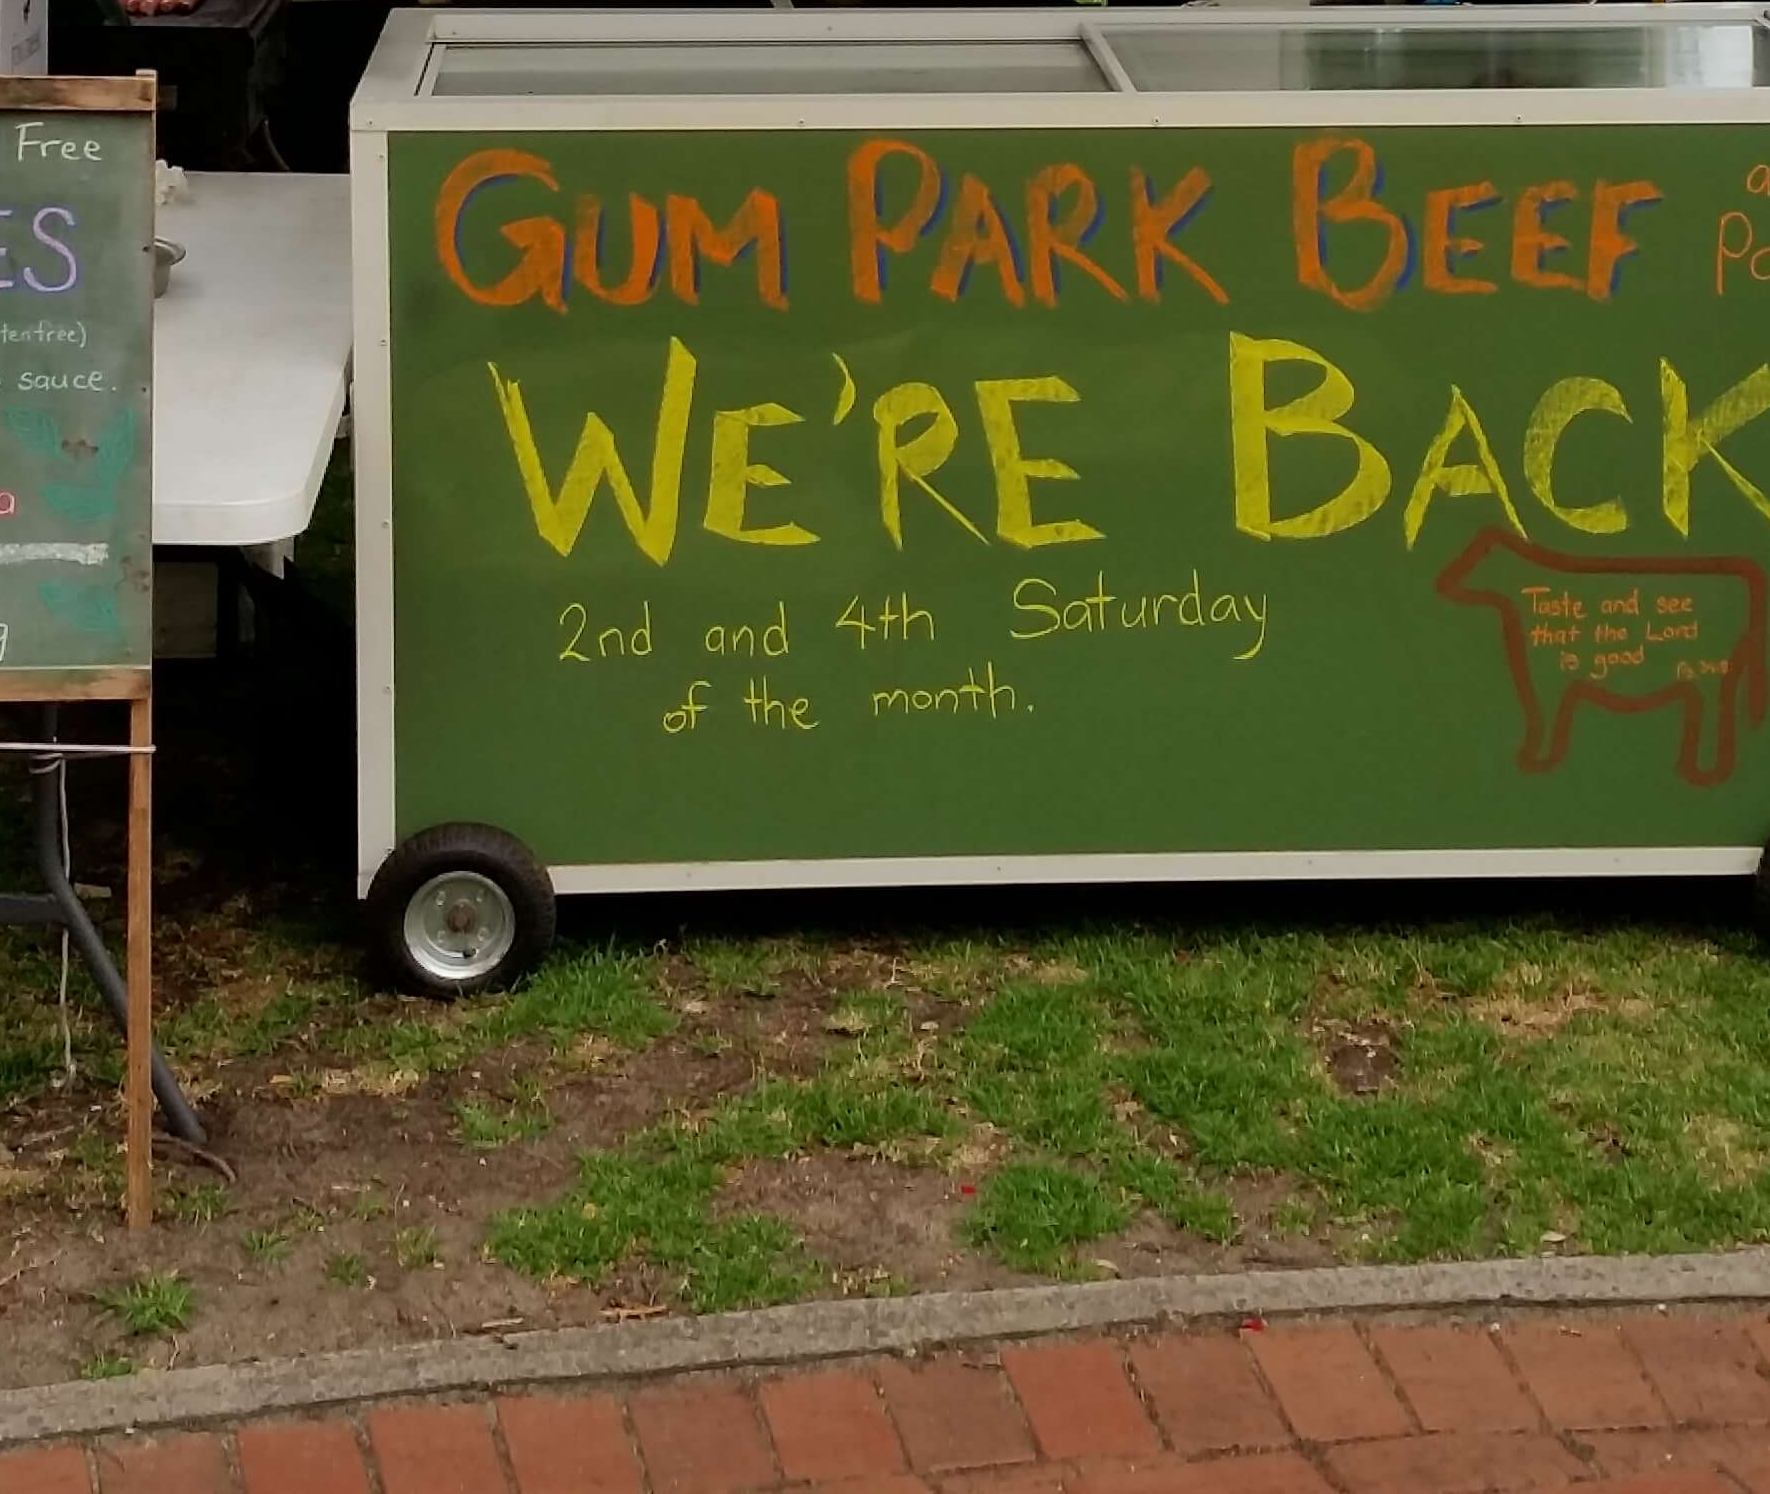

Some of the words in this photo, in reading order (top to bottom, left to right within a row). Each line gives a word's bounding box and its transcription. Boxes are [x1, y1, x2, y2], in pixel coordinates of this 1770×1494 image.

[15, 121, 104, 162] Free
[434, 147, 791, 314] GUM
[847, 139, 1230, 308] PARK
[1291, 134, 1665, 314] BEEF
[16, 369, 118, 393] sauce.
[485, 336, 1107, 568] WE'RE
[559, 602, 653, 661] 2nd
[705, 602, 789, 656] and
[835, 592, 936, 650] 4th
[1010, 568, 1270, 660] Saturday
[1521, 587, 1587, 619] Taste
[1600, 589, 1639, 615] and
[1656, 596, 1693, 614] see
[1530, 623, 1581, 647] that
[1594, 623, 1628, 643] the
[1646, 621, 1698, 641] Lord
[1559, 653, 1579, 670] is
[1591, 645, 1645, 679] good
[662, 680, 711, 733] of
[744, 677, 819, 729] the
[872, 661, 1035, 717] month.
